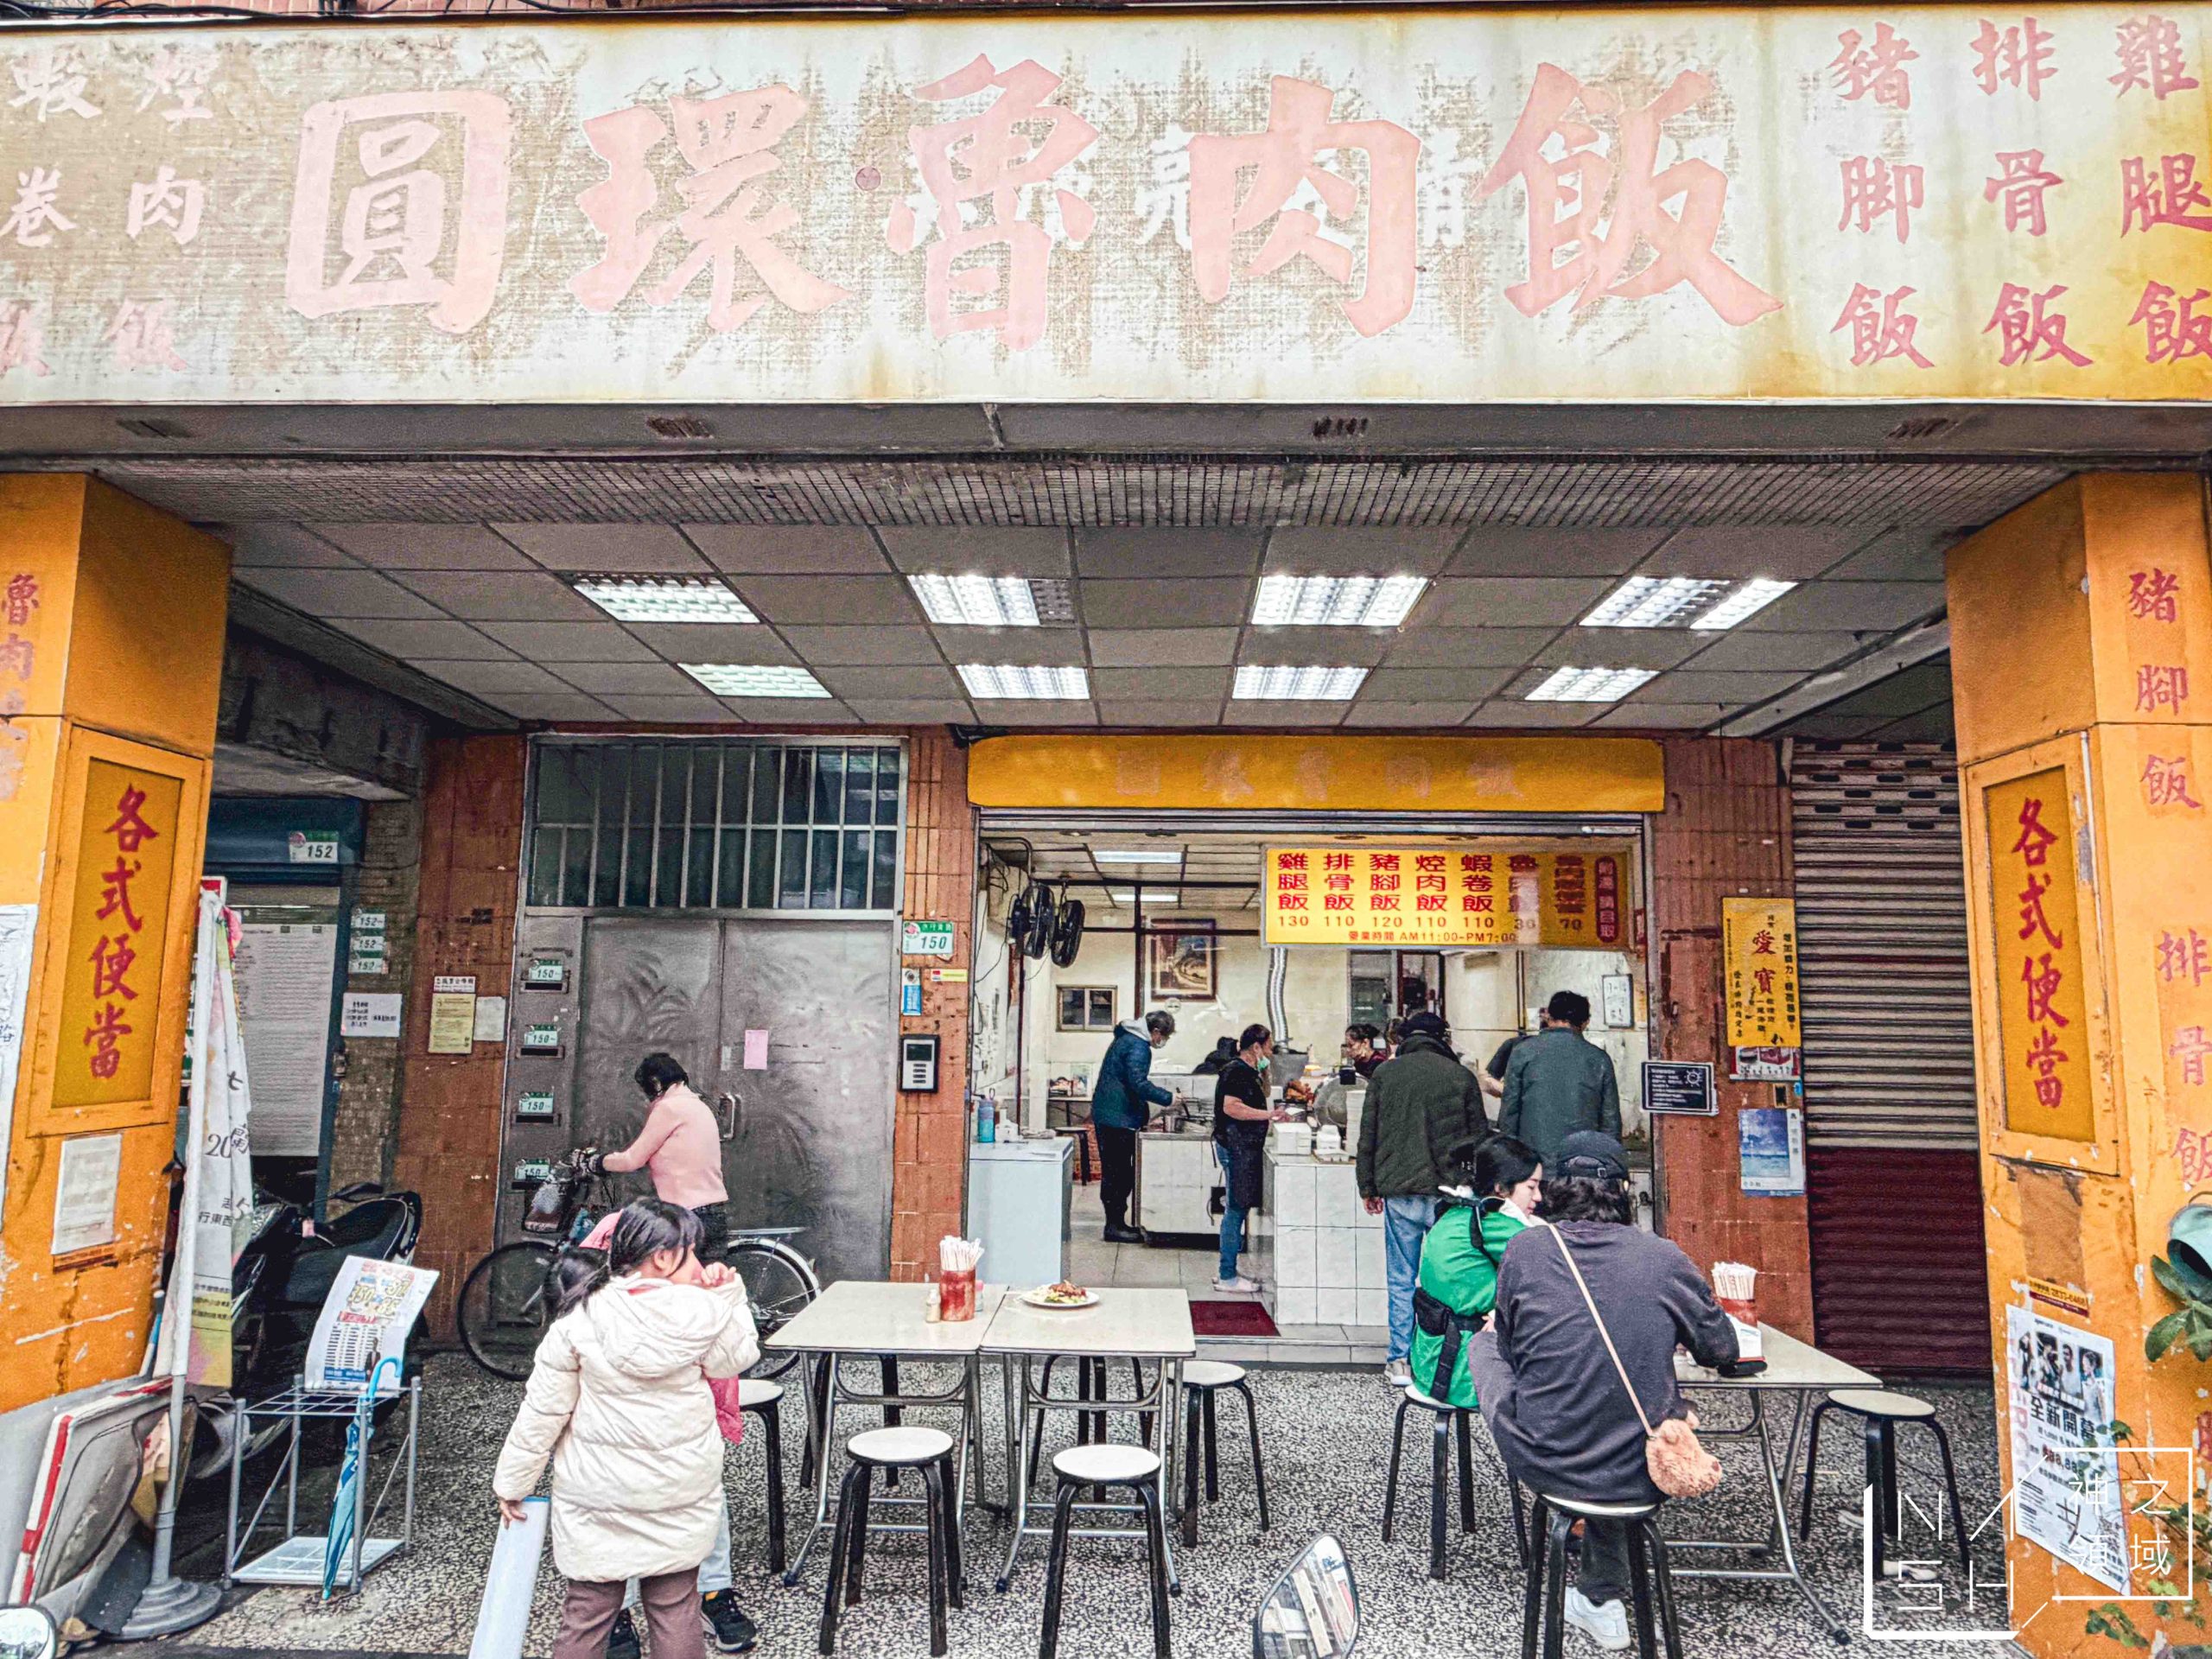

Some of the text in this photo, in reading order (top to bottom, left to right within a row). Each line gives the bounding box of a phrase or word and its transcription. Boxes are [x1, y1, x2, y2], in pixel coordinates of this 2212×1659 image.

[1969, 17, 2093, 367] 排骨飯
[2107, 15, 2212, 366] 雞腿飯
[285, 54, 1783, 351] 圓環魯肉飯
[2129, 569, 2202, 810] 豬腳飯
[308, 844, 334, 858] 152
[1277, 853, 1309, 911] 雞腿飯
[1323, 853, 1355, 911] 排骨飯
[1461, 855, 1493, 912] 蝦卷飯
[1279, 916, 1309, 926] 130
[1325, 916, 1355, 926] 110
[1372, 917, 1402, 927] 120
[1416, 917, 1446, 927] 110
[1464, 917, 1494, 928] 110
[1560, 918, 1584, 931] 70
[84, 784, 159, 1078] 各式便當
[1349, 931, 1394, 942] 營業時間
[921, 936, 947, 949] 150
[2012, 797, 2069, 1109] 各式便當
[537, 969, 555, 978] 150
[532, 1033, 550, 1043] 150
[2157, 928, 2212, 1182] 排骨飯
[527, 1101, 544, 1110] 150
[2029, 1395, 2096, 1442] 全新開幕
